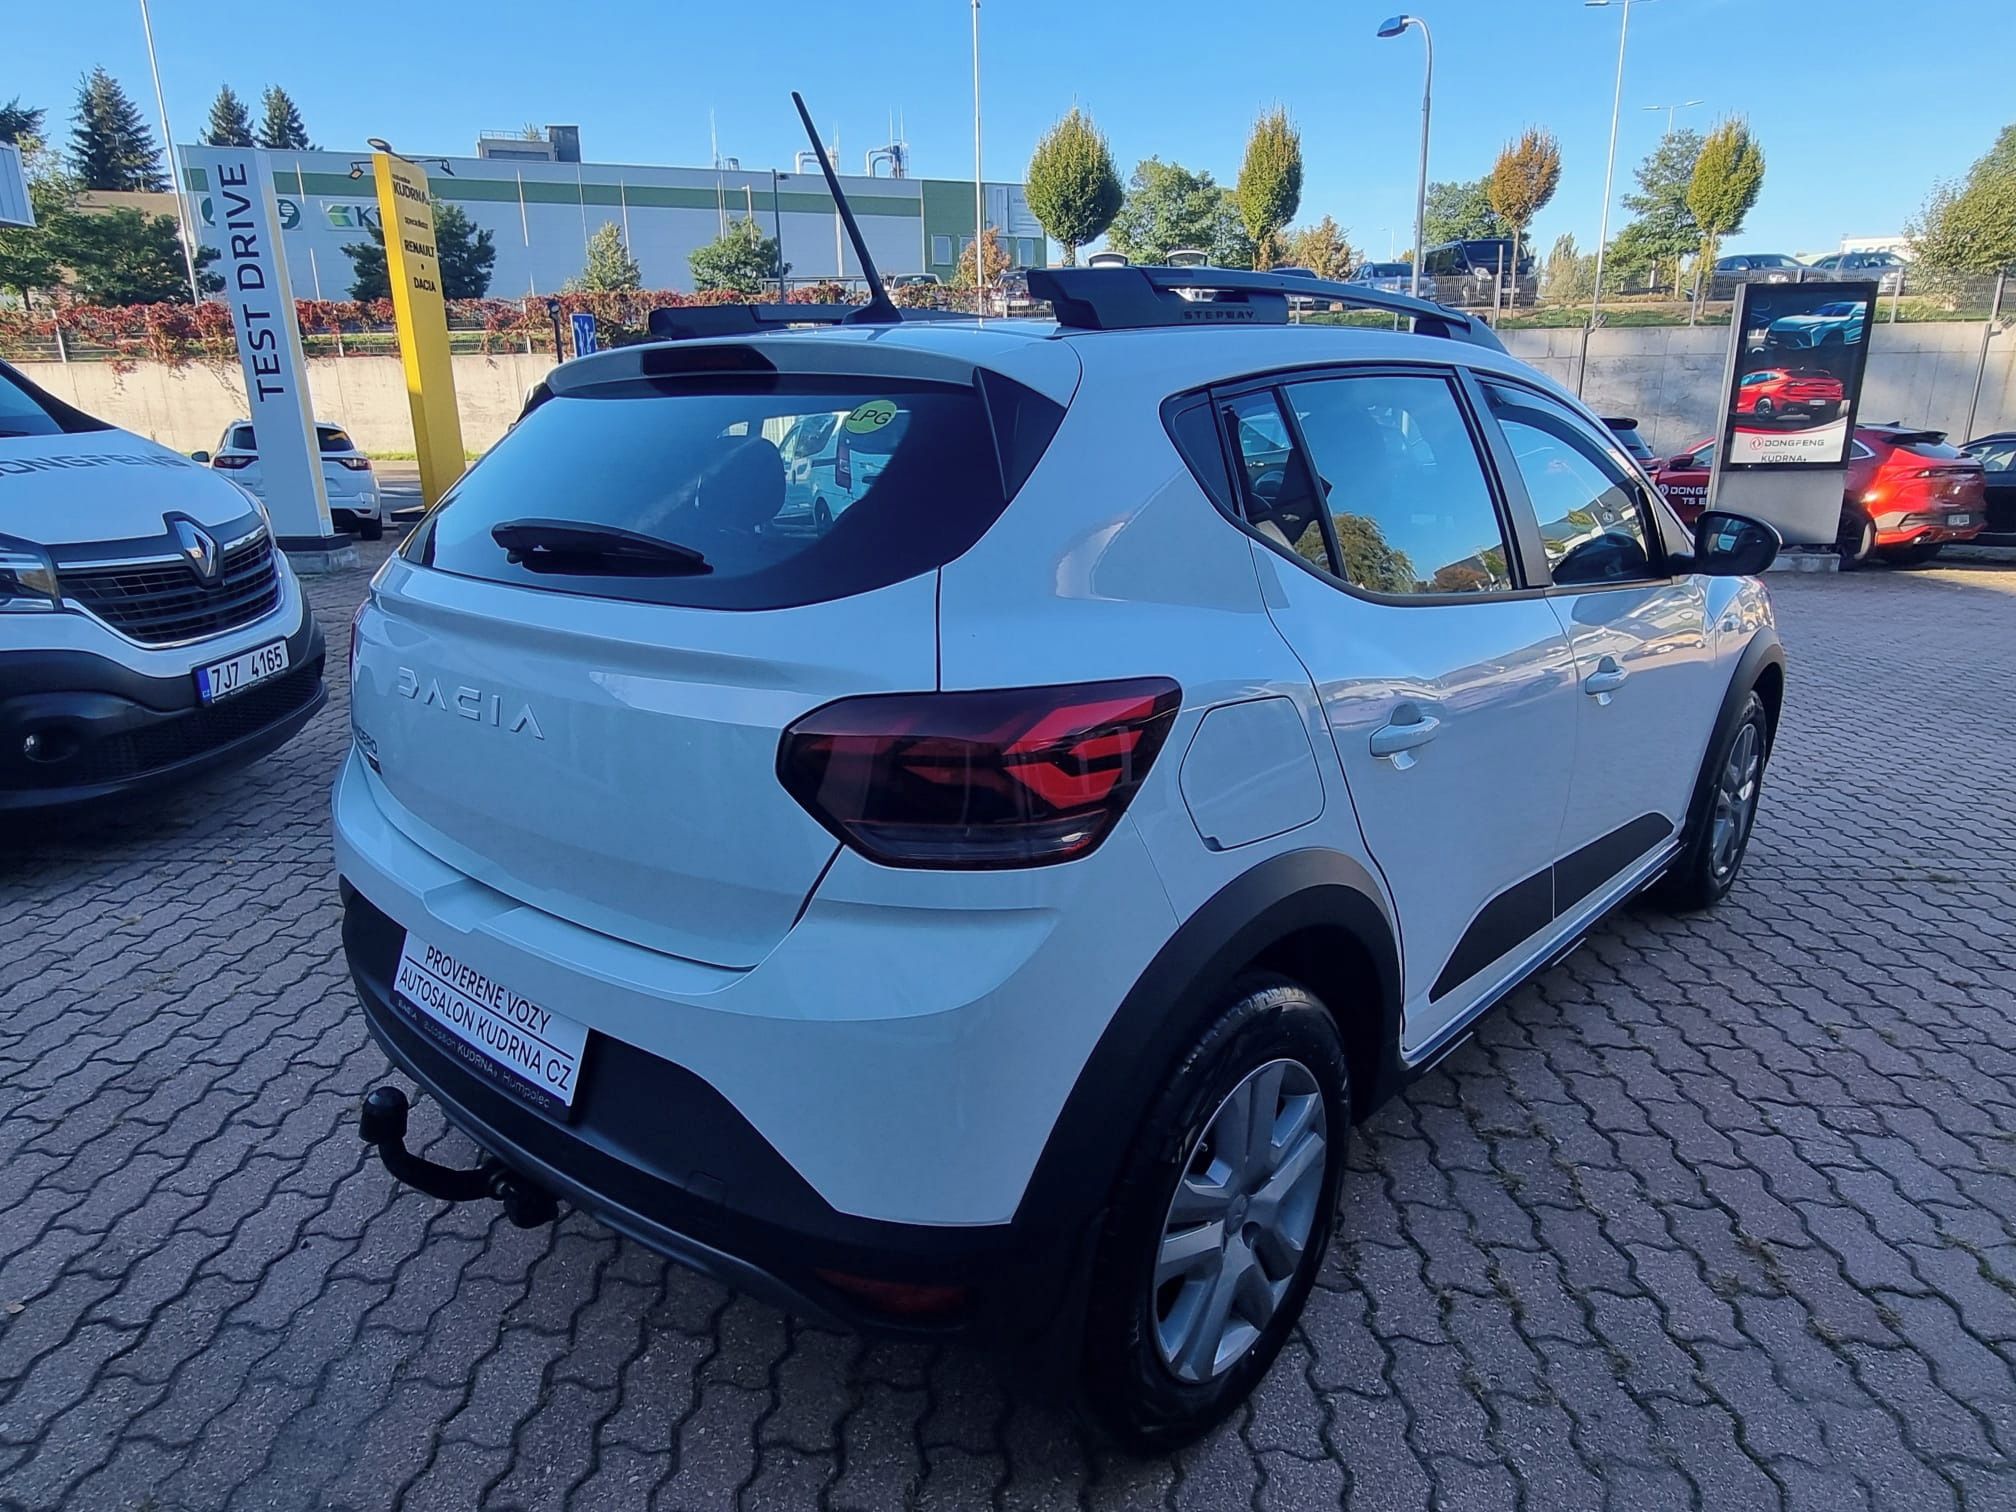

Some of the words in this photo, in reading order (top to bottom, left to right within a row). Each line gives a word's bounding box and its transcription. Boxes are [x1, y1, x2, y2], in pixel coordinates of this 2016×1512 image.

[217, 163, 265, 291] DRIVE
[404, 239, 434, 258] RENAULT
[413, 276, 437, 292] DACIA
[1184, 310, 1254, 320] STEPWAY
[242, 304, 284, 402] TEST
[850, 409, 891, 425] LPG
[1764, 439, 1825, 447] DONGFENG
[0, 454, 192, 477] ONGFENG
[211, 662, 239, 694] 7J7
[251, 645, 283, 677] 4165
[396, 667, 544, 741] DACIA
[425, 945, 505, 1010] PROVERENE
[507, 992, 552, 1034] VOZY
[399, 966, 475, 1031] AUTOSALON
[476, 1015, 541, 1074] KUDRNA
[546, 1058, 572, 1091] CZ
[503, 1071, 551, 1108] Humpolec
